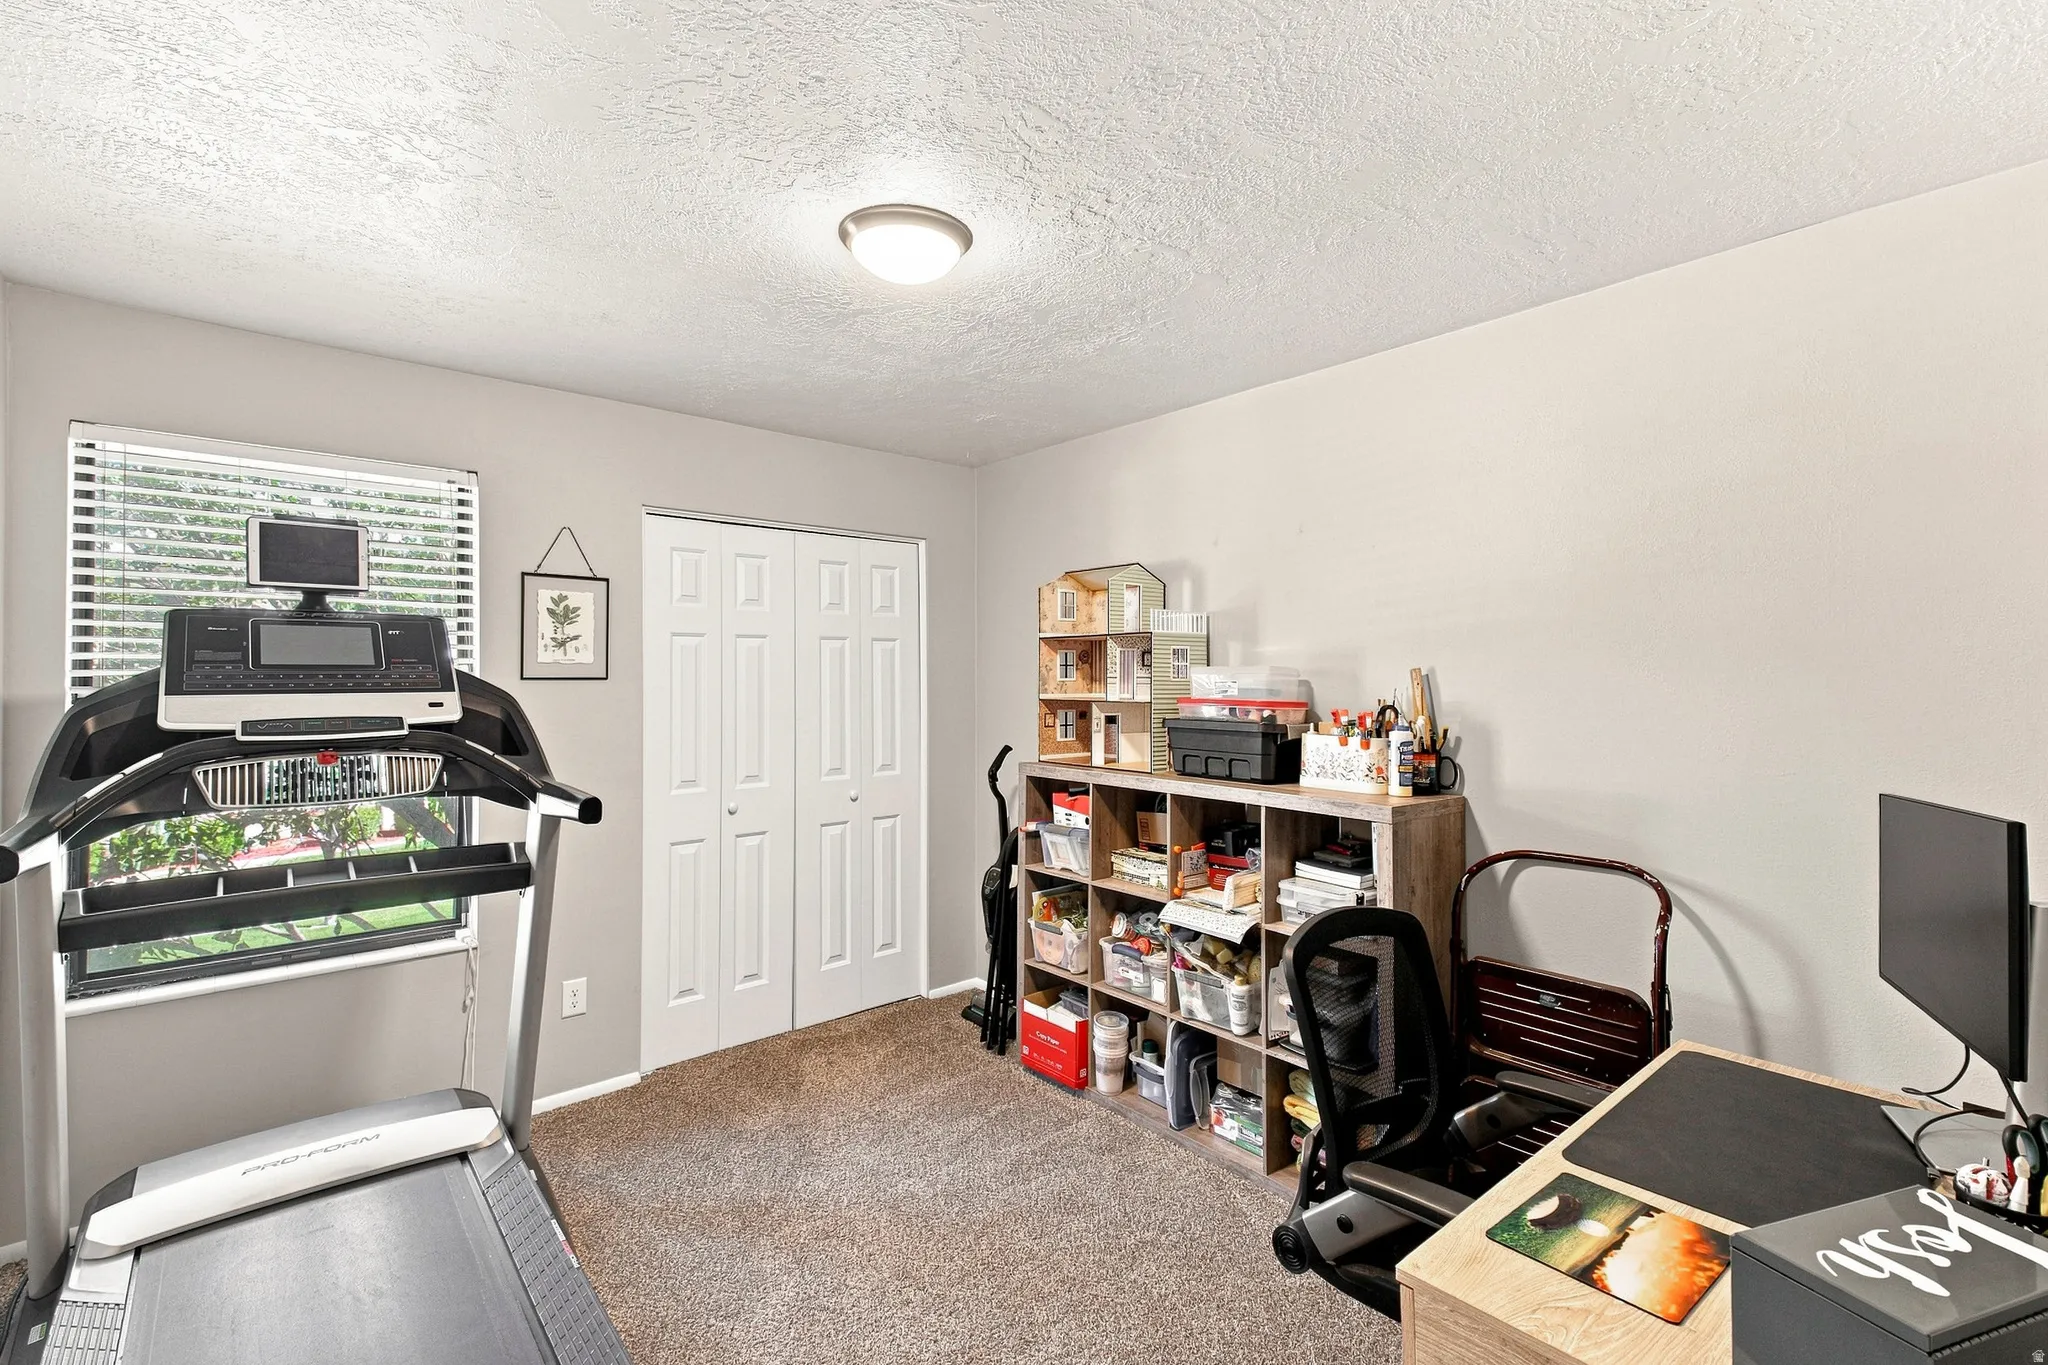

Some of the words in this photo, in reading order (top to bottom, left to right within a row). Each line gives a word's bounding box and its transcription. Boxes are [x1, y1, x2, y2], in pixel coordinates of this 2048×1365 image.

[1036, 1030, 1047, 1041] Copy
[1047, 1035, 1060, 1046] Paper
[241, 1133, 381, 1176] PRO-FORM
